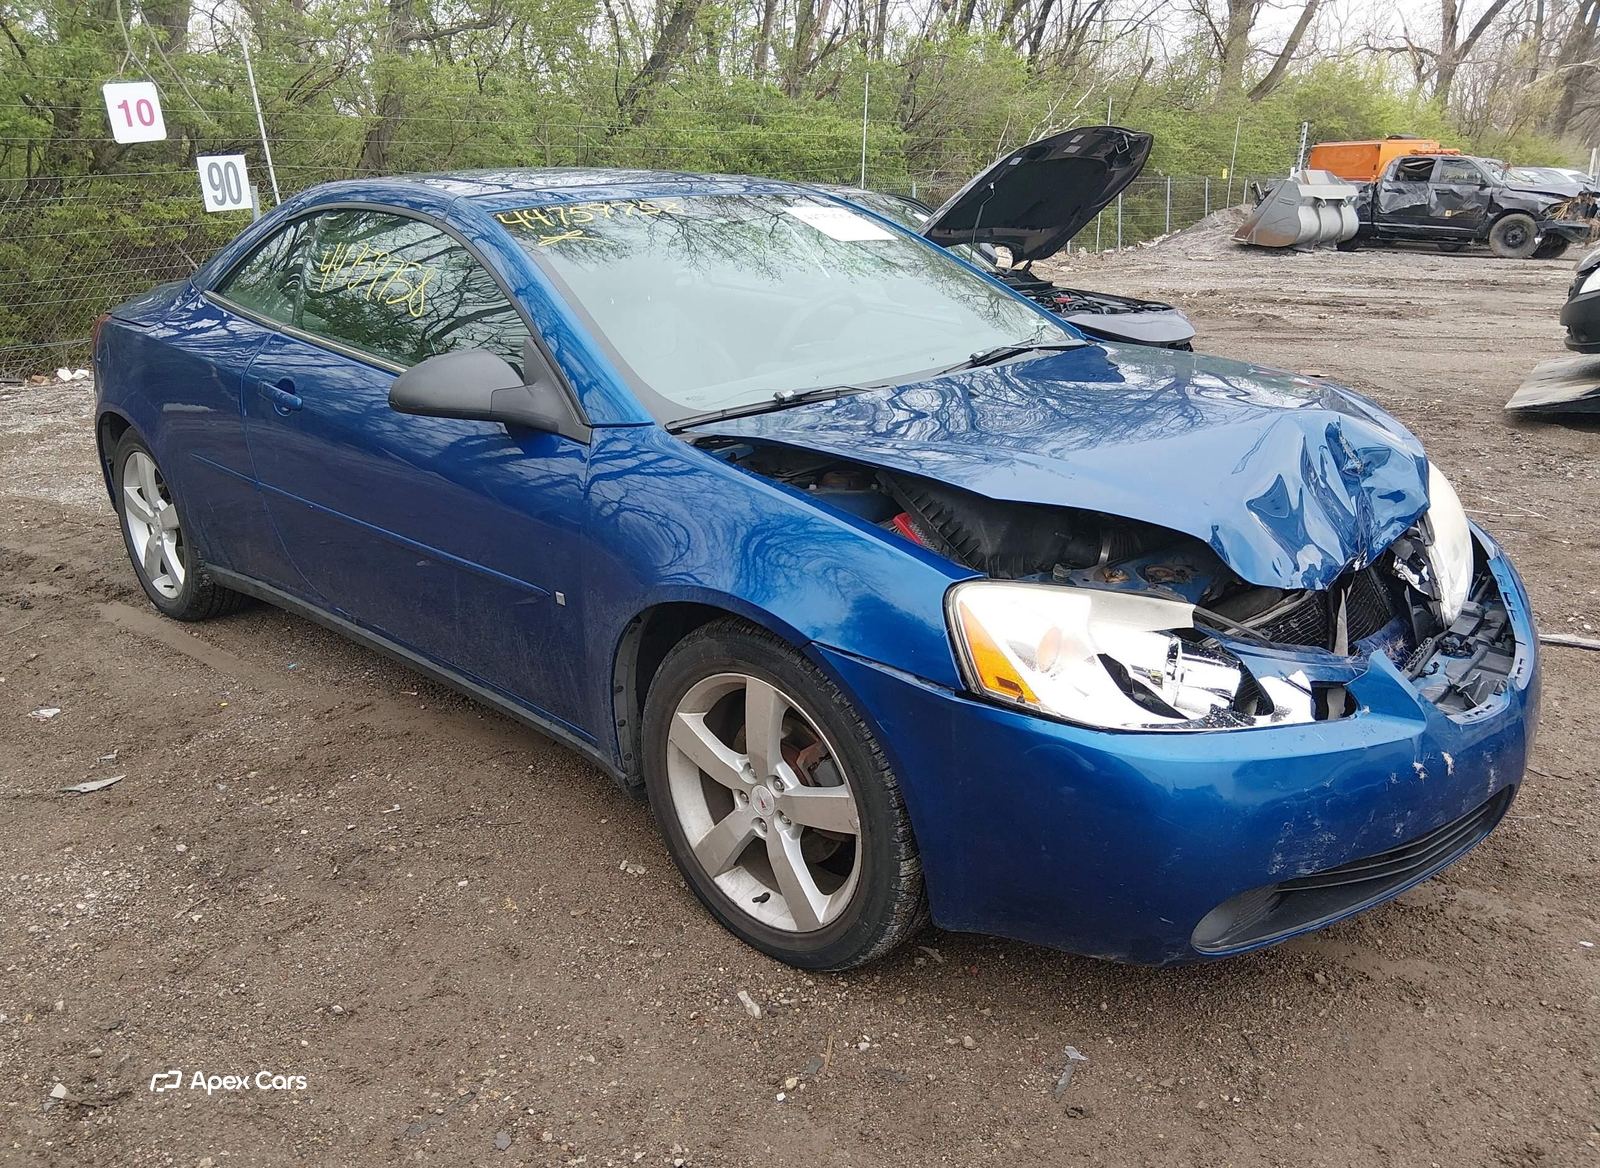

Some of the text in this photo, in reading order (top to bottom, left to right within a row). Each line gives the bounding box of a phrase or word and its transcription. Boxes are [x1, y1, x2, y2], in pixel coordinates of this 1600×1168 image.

[117, 98, 155, 128] 10
[207, 160, 242, 206] 90
[497, 200, 685, 230] 44759758
